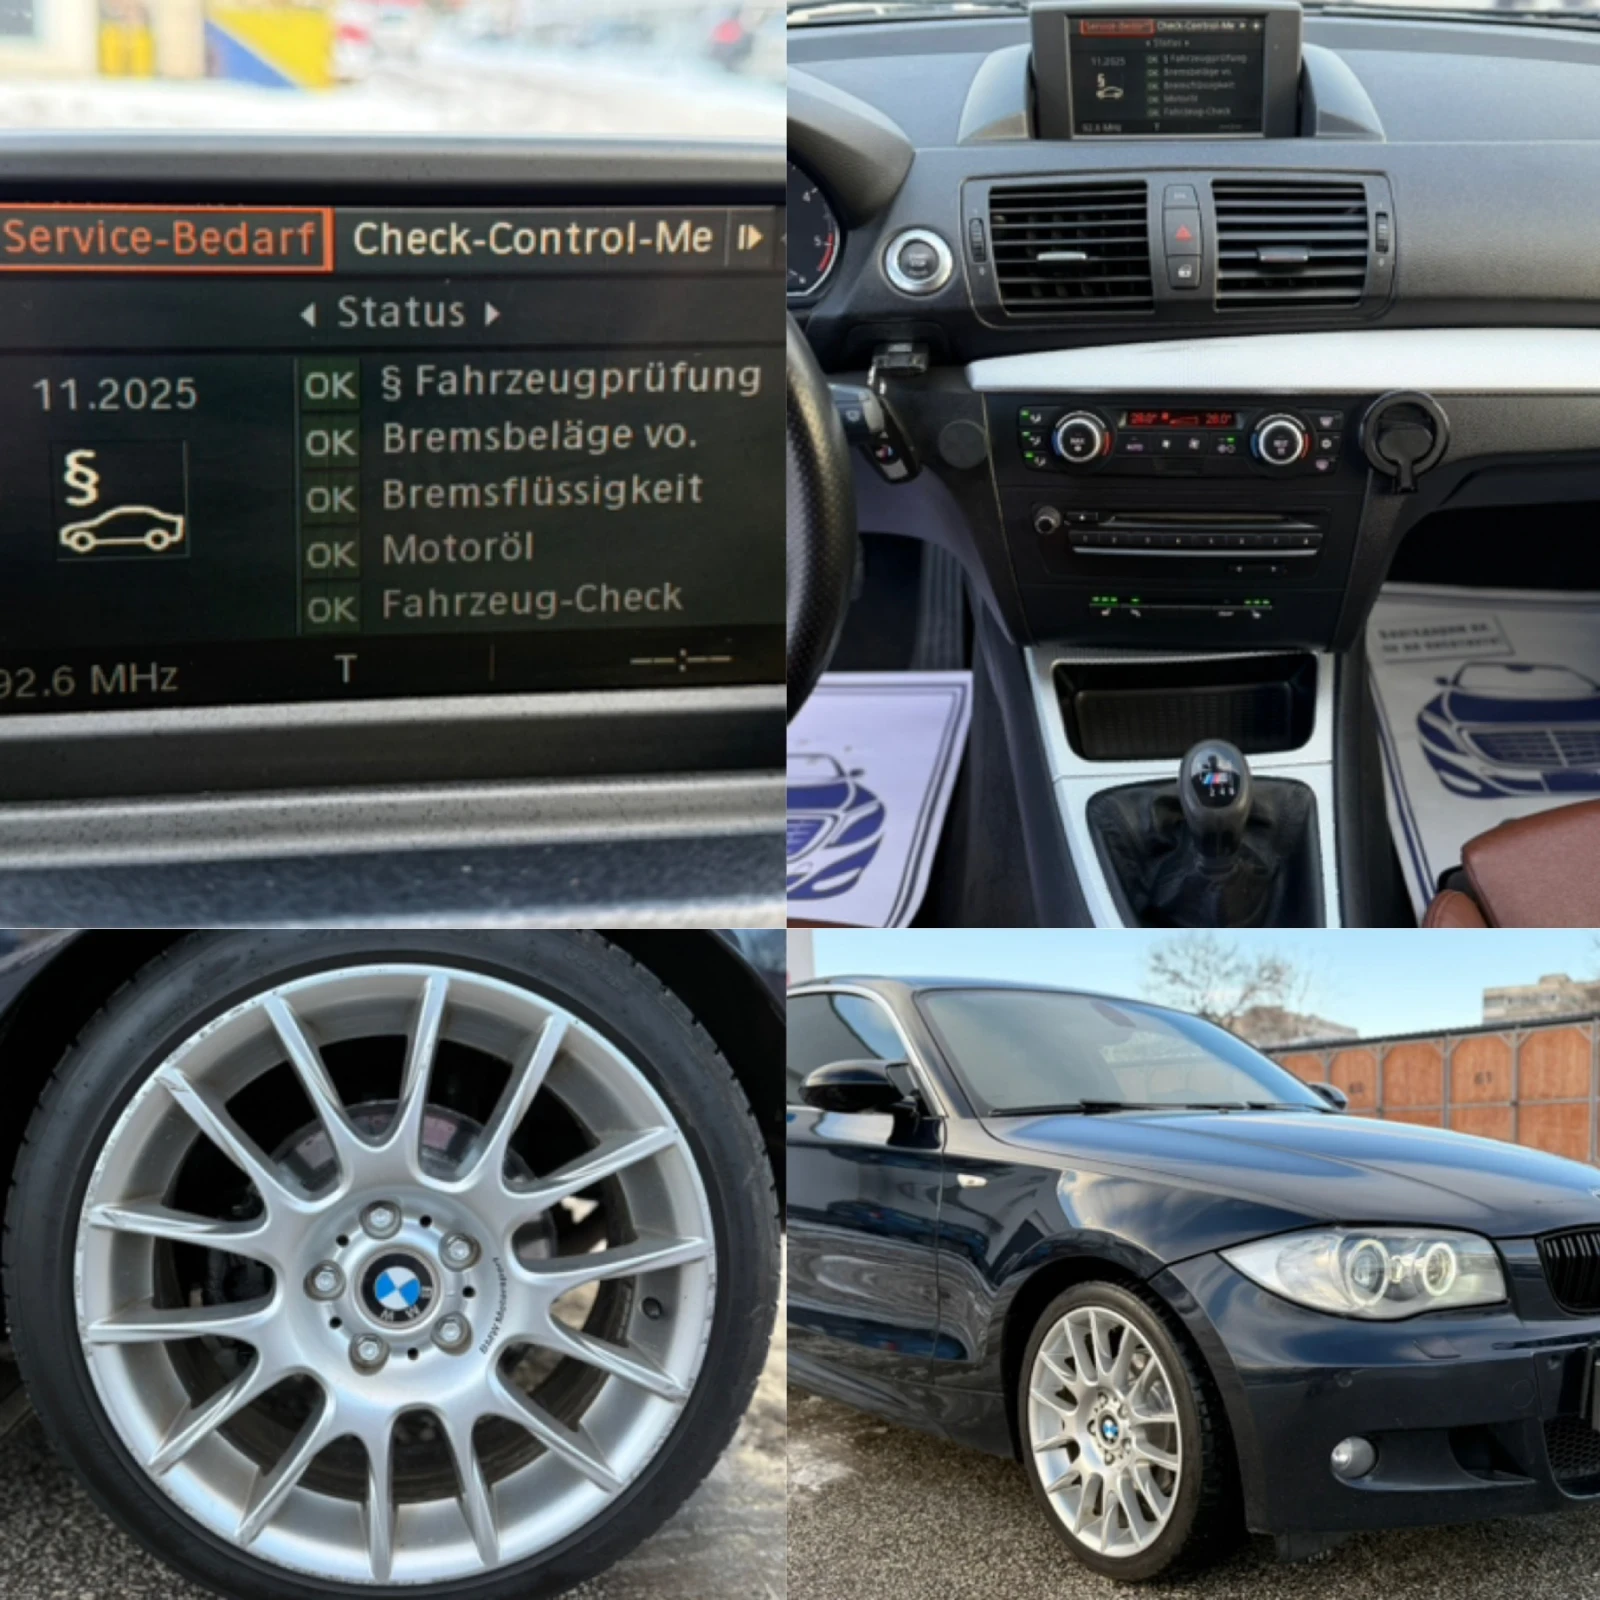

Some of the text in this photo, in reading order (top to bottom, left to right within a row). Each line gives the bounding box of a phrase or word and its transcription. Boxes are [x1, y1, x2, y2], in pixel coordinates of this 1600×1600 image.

[3, 218, 316, 256] Service-Bedarf
[353, 220, 714, 256] Check-Control-Me
[337, 295, 466, 329] Status
[33, 376, 199, 412] 11.2025
[305, 371, 357, 400] OK
[416, 361, 762, 400] Fahrzeugprüfung
[305, 429, 357, 458] OK
[383, 419, 698, 456] Bremsbeläge vo.
[305, 485, 356, 514] OK
[383, 473, 703, 511] Bremsflüssigkeit
[306, 541, 356, 570] OK
[382, 531, 534, 565] Motoröl
[307, 596, 356, 625] OK
[382, 581, 683, 620] Fahrzeug-Check
[0, 661, 179, 699] 92.6 MHz
[335, 652, 358, 684] T
